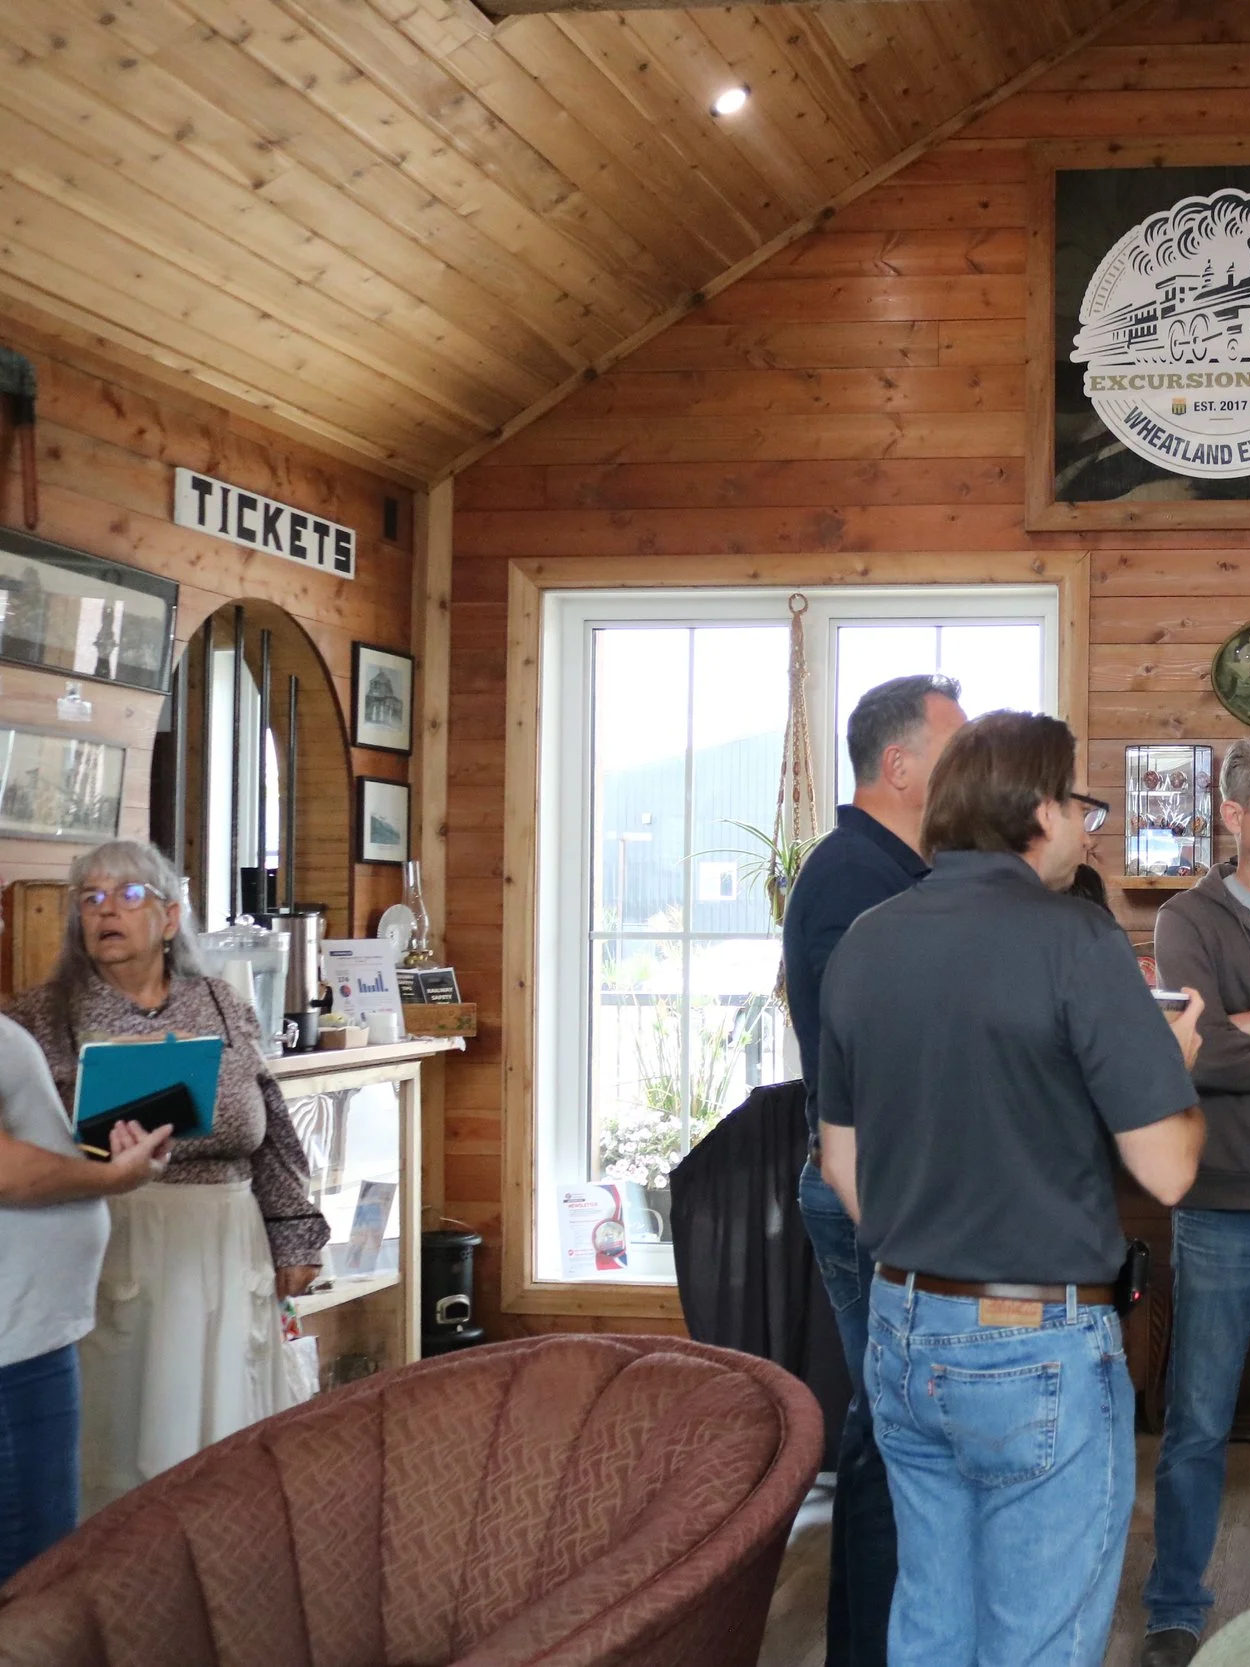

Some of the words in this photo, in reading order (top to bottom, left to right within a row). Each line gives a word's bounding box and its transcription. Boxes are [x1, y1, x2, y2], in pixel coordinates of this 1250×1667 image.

[1123, 406, 1233, 466] WHEATLAND
[1193, 400, 1217, 412] EST.
[1219, 400, 1248, 412] 2017
[191, 475, 352, 574] TICKETS
